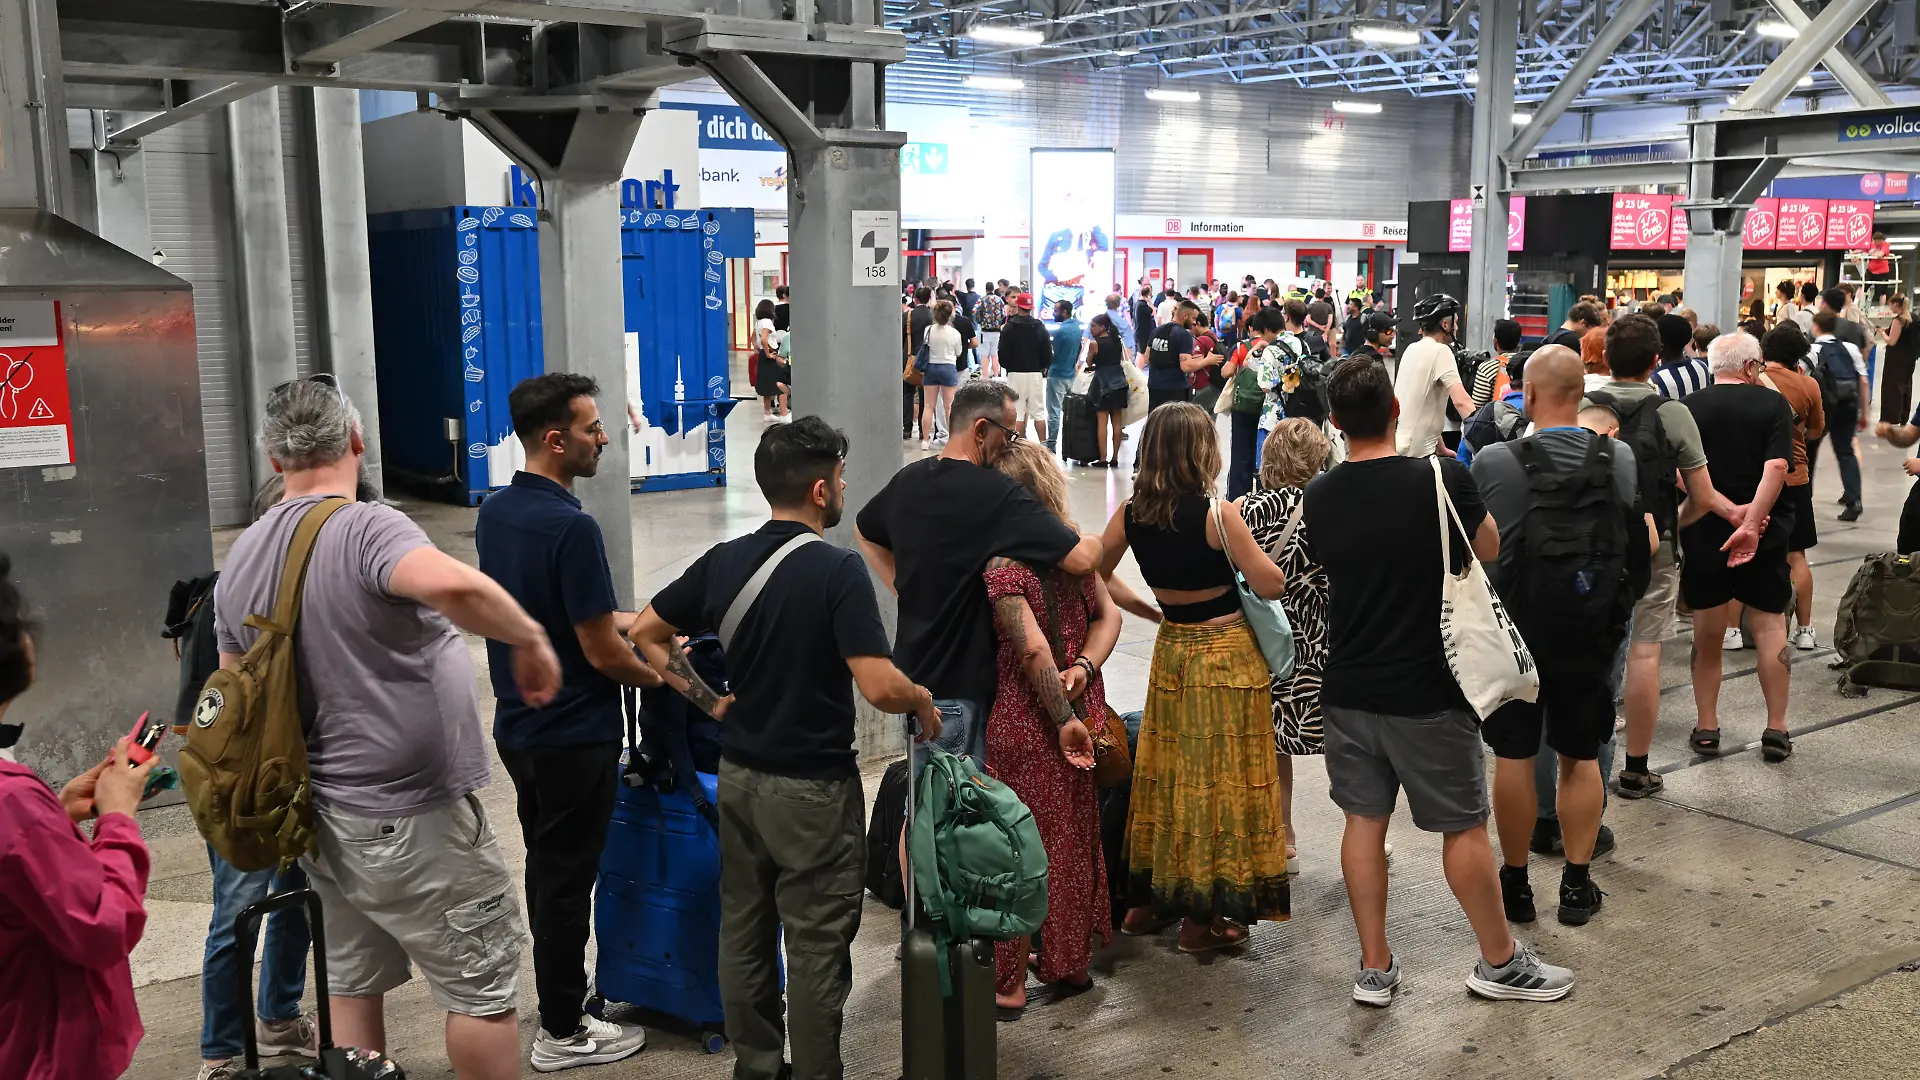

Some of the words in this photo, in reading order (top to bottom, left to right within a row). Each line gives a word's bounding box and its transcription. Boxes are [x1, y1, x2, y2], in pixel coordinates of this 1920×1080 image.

[707, 114, 747, 140] dich
[698, 168, 740, 182] bank.
[1864, 180, 1878, 188] Bus
[1887, 178, 1908, 187] Tram
[1615, 198, 1624, 208] ab
[1625, 200, 1635, 209] 23
[1637, 198, 1650, 209] Uhr
[1789, 204, 1798, 213] 23
[1799, 204, 1810, 213] Uhr
[1167, 221, 1180, 232] DB
[1190, 222, 1244, 232] Information
[1364, 225, 1374, 235] DB
[1383, 226, 1408, 235] Reisez
[1642, 221, 1662, 241] Preis
[1753, 224, 1770, 241] Preis
[1803, 224, 1819, 242] Preis
[1851, 225, 1867, 241] Preis
[865, 266, 886, 278] 158
